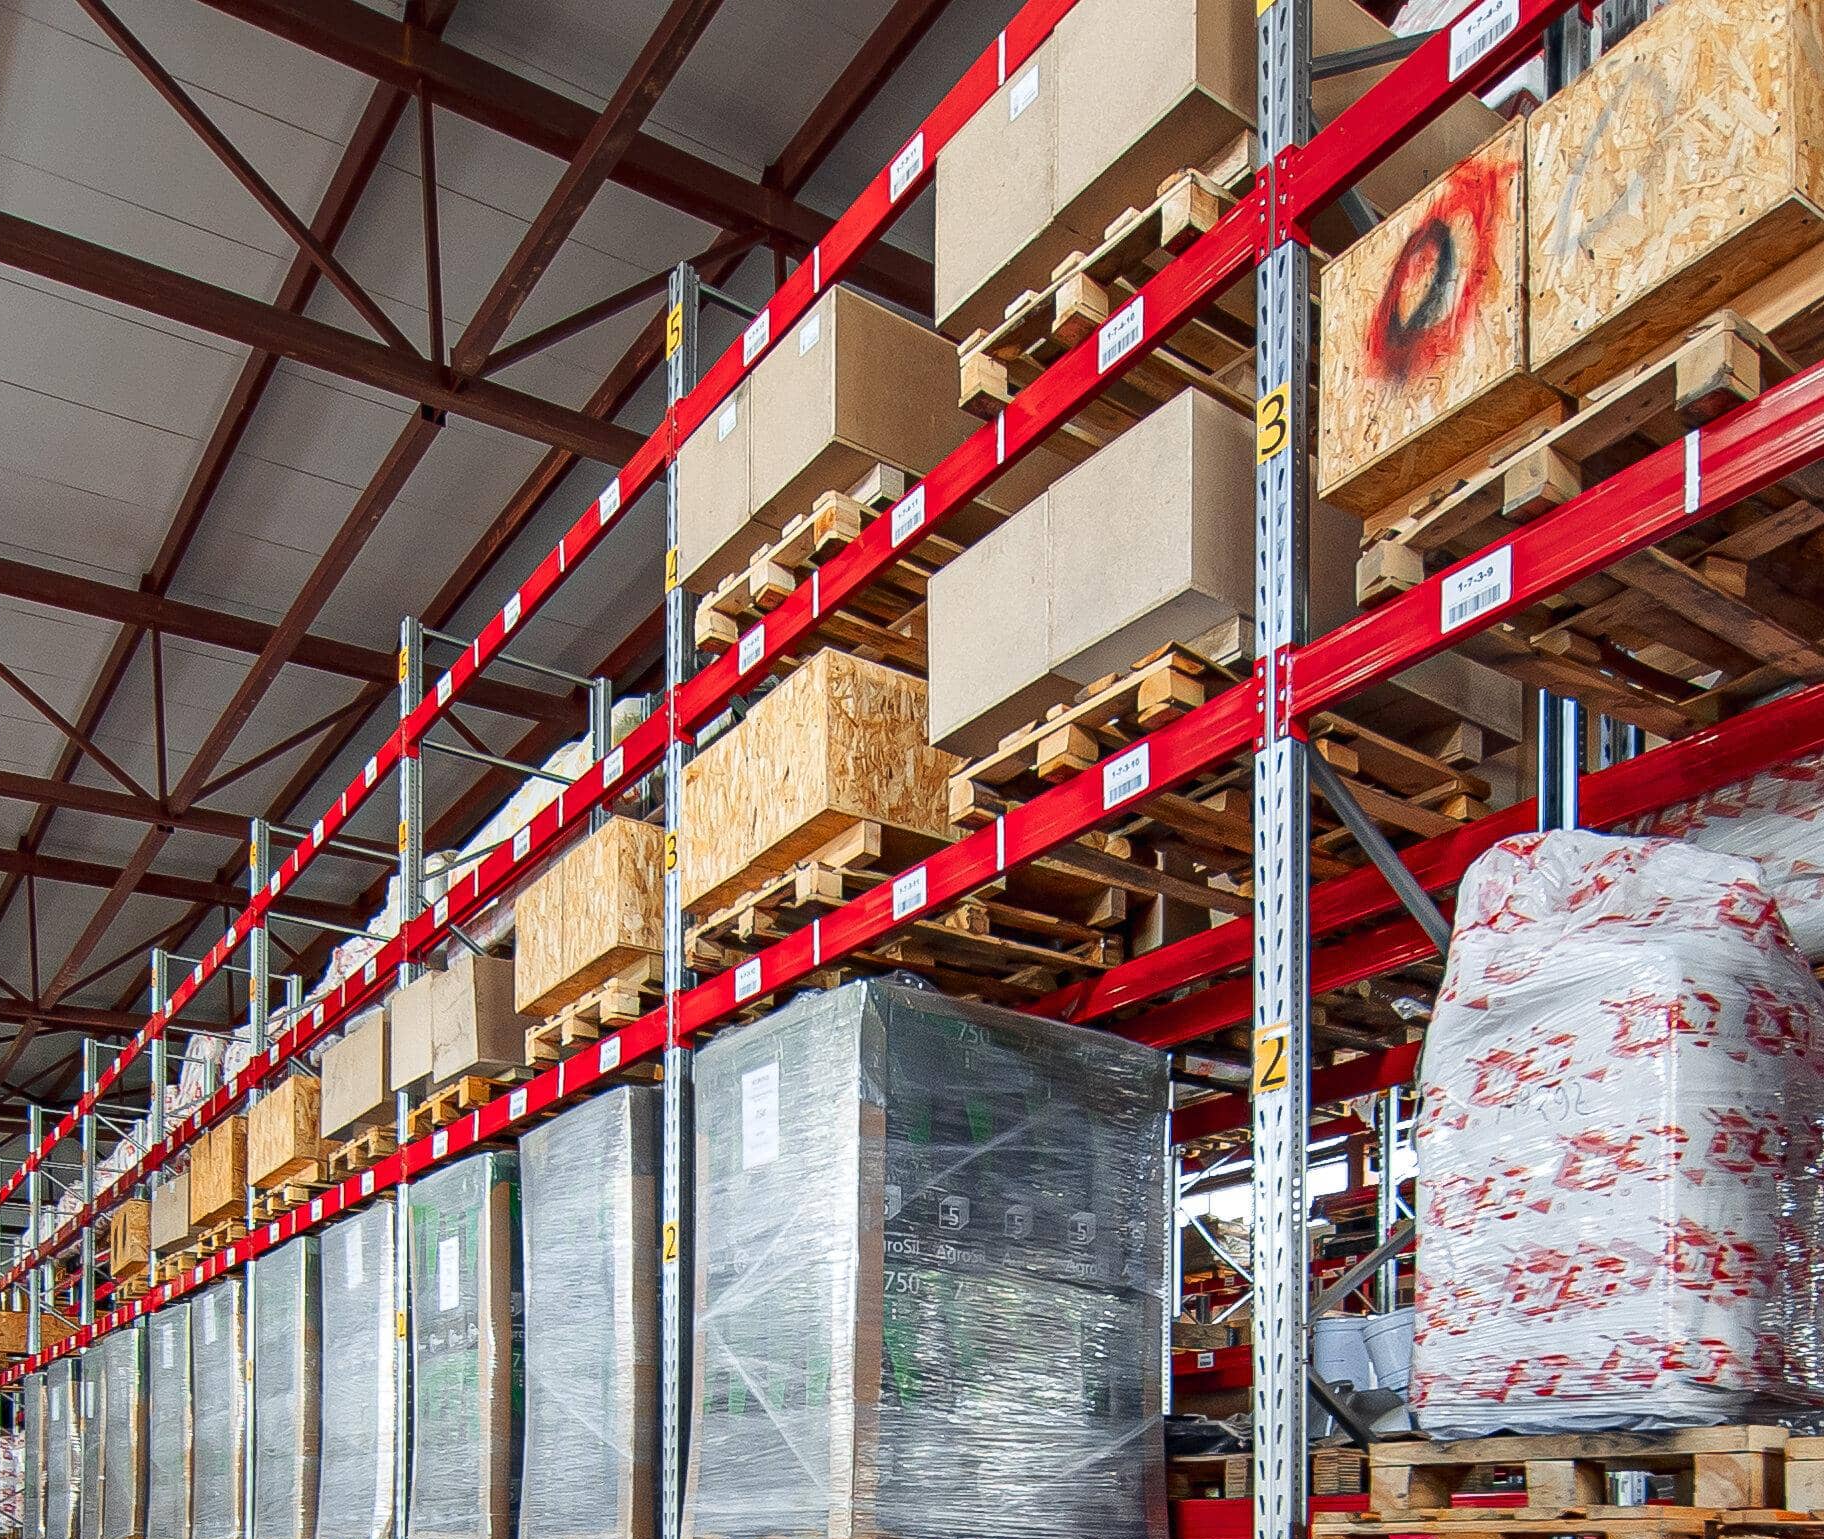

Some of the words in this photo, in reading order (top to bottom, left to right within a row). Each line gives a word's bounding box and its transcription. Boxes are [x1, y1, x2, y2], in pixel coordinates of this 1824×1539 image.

[670, 311, 680, 354] 5
[1260, 393, 1287, 456] 3
[1456, 565, 1494, 593] 1-7-3-9
[666, 834, 677, 868] 3
[1259, 1034, 1286, 1089] 2
[665, 1225, 677, 1260] 2
[884, 1271, 920, 1295] 750
